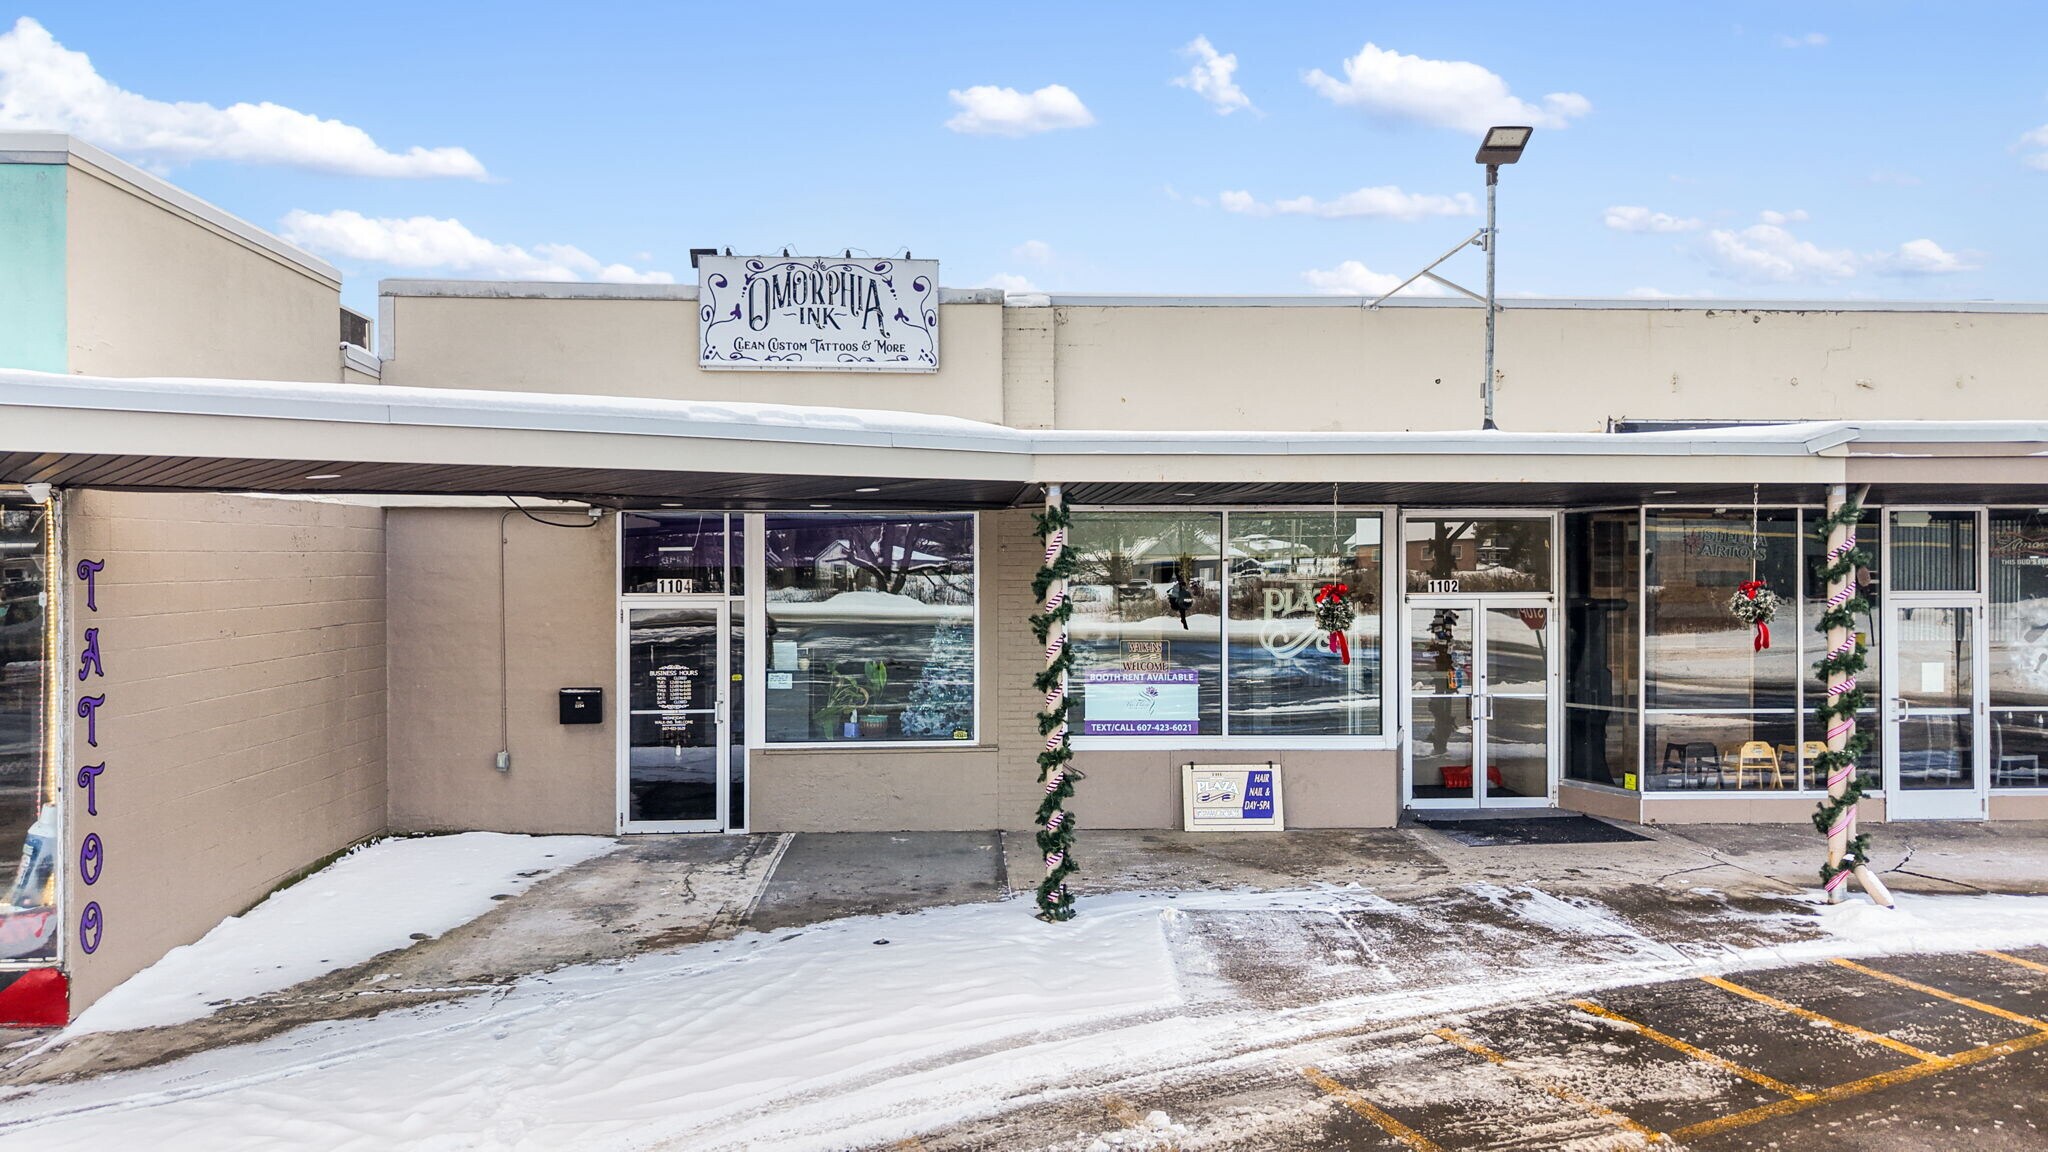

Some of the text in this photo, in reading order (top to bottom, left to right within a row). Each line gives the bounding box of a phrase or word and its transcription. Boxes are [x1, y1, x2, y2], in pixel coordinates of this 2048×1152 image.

[749, 270, 890, 338] OMORPHIA
[800, 307, 841, 329] INK
[862, 341, 872, 351] &
[659, 580, 691, 593] 1104
[1429, 580, 1458, 592] 1102
[1262, 587, 1322, 620] PLA
[1123, 661, 1168, 671] WELCOME
[1090, 673, 1194, 681] BOOTH RENT AVAILABLE
[1091, 723, 1192, 732] TEXT/CALL 607-423-6021
[77, 558, 105, 954] TATTOO
[1254, 773, 1270, 783] HAIR
[1196, 781, 1239, 795] PLAZA
[1249, 787, 1271, 797] NAIL &
[1244, 800, 1270, 810] DAY-SPA
